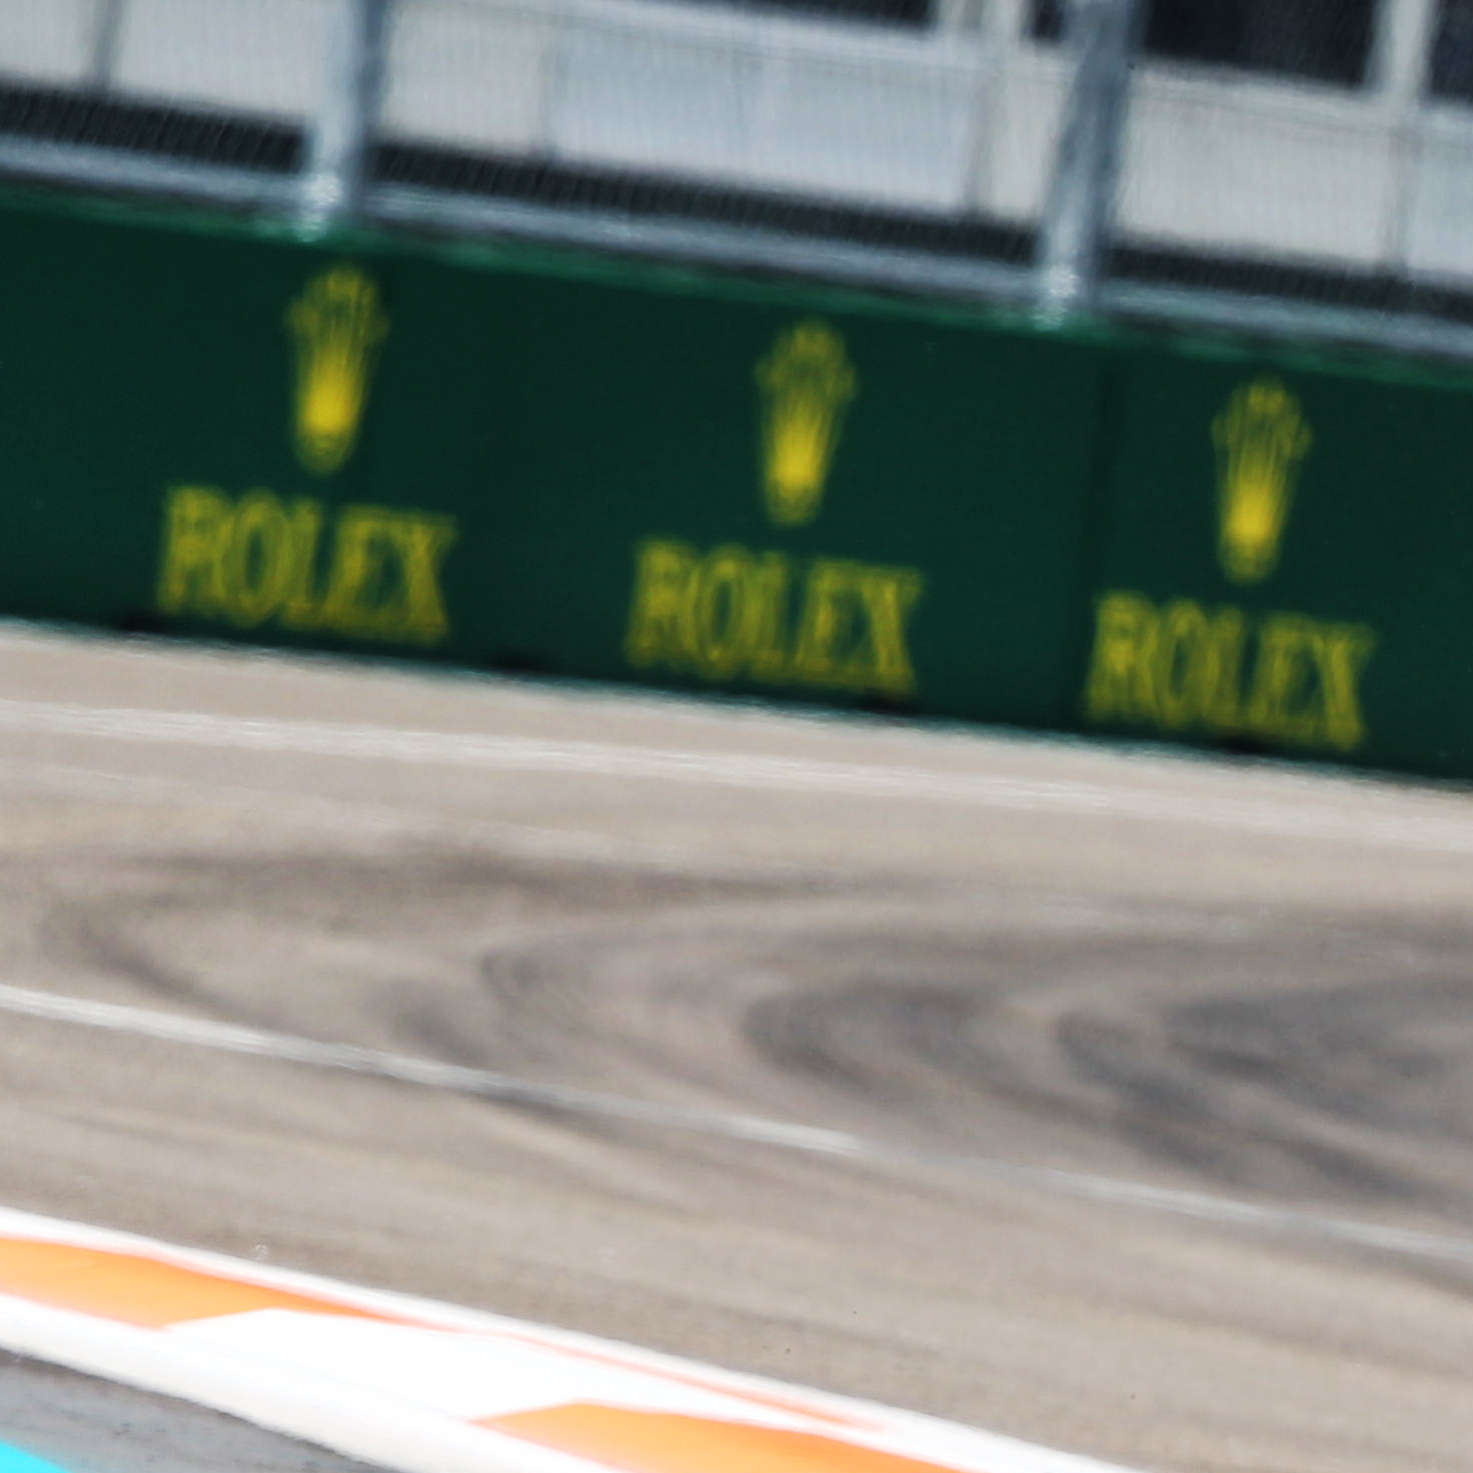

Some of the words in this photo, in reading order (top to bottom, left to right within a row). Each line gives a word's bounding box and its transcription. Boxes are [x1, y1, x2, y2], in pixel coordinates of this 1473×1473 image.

[157, 484, 453, 642] ROLEX
[625, 537, 921, 695] ROLEX
[1085, 591, 1368, 750] ROLEX
